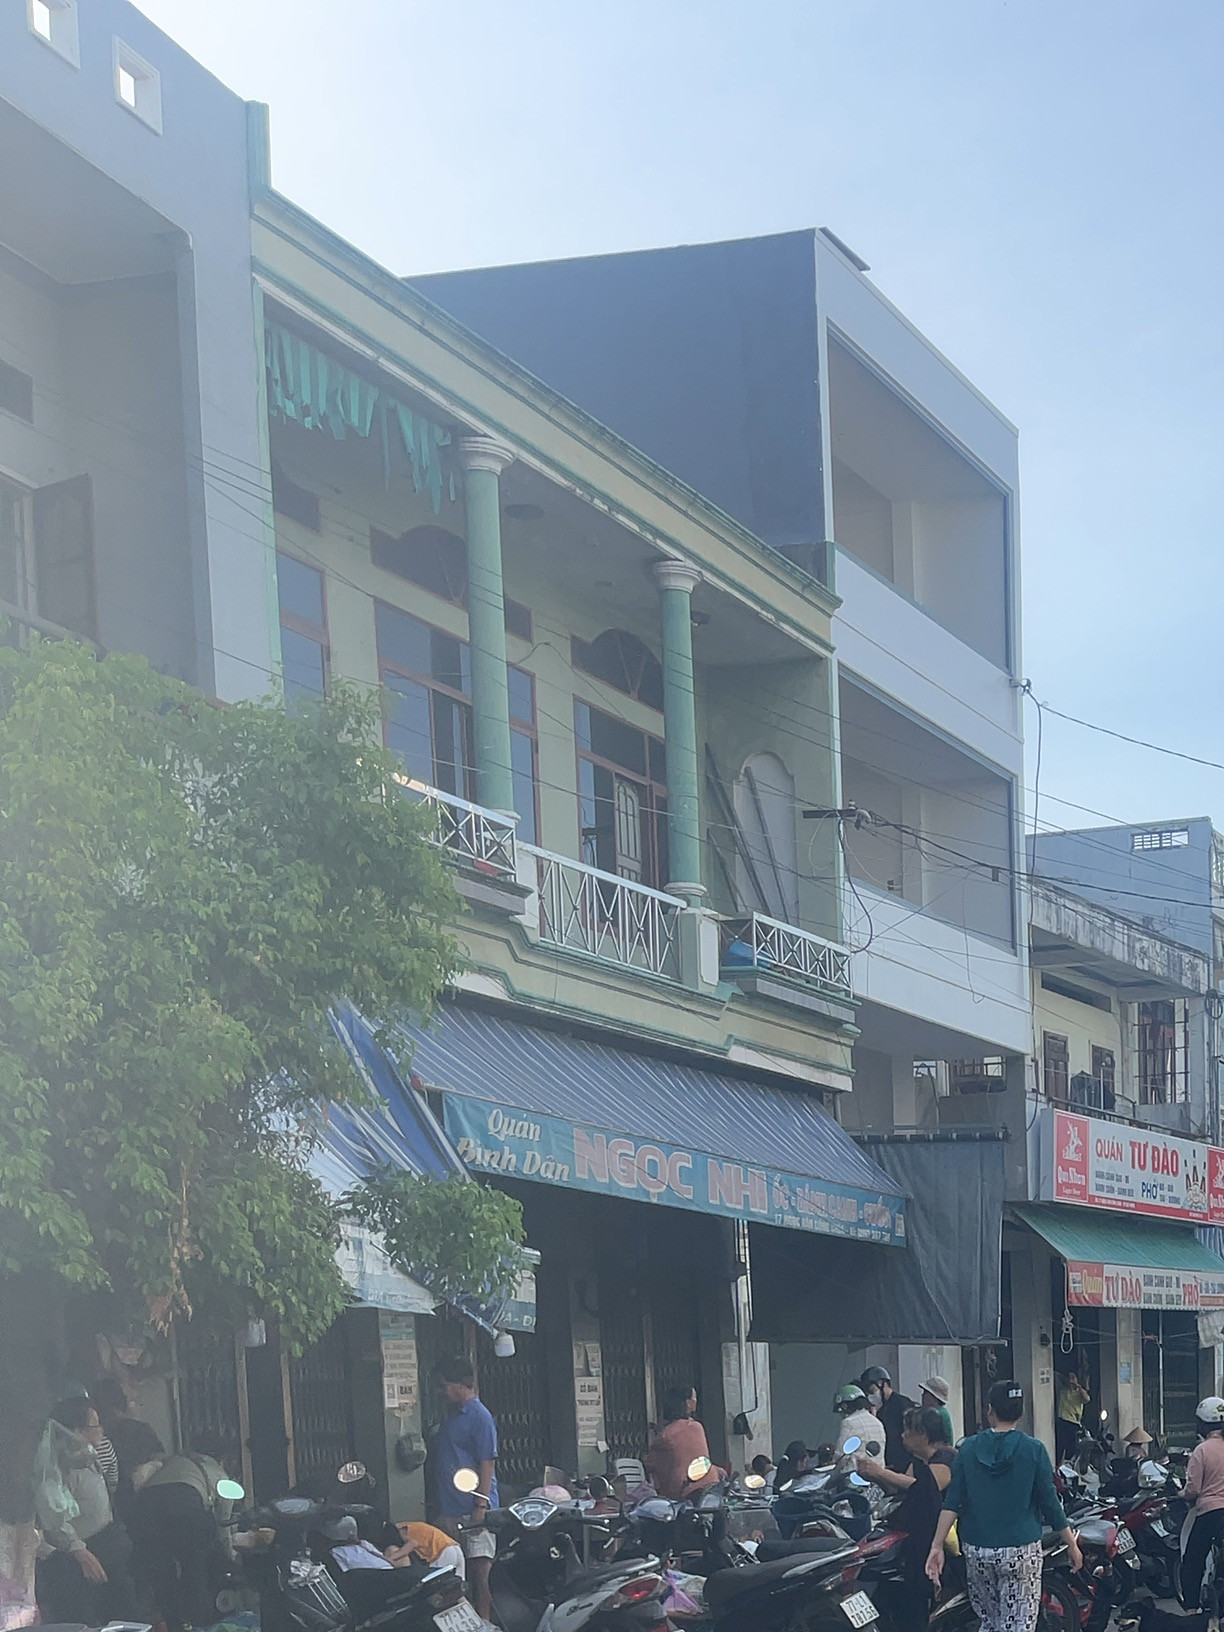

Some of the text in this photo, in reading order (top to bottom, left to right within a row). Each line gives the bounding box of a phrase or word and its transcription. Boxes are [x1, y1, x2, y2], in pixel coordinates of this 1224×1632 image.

[523, 1149, 570, 1183] Dân
[573, 1127, 768, 1214] NGỌC NHI
[1095, 1135, 1124, 1162] QUÁN
[1129, 1140, 1149, 1172] TƯ
[1151, 1141, 1179, 1178] ĐÀO
